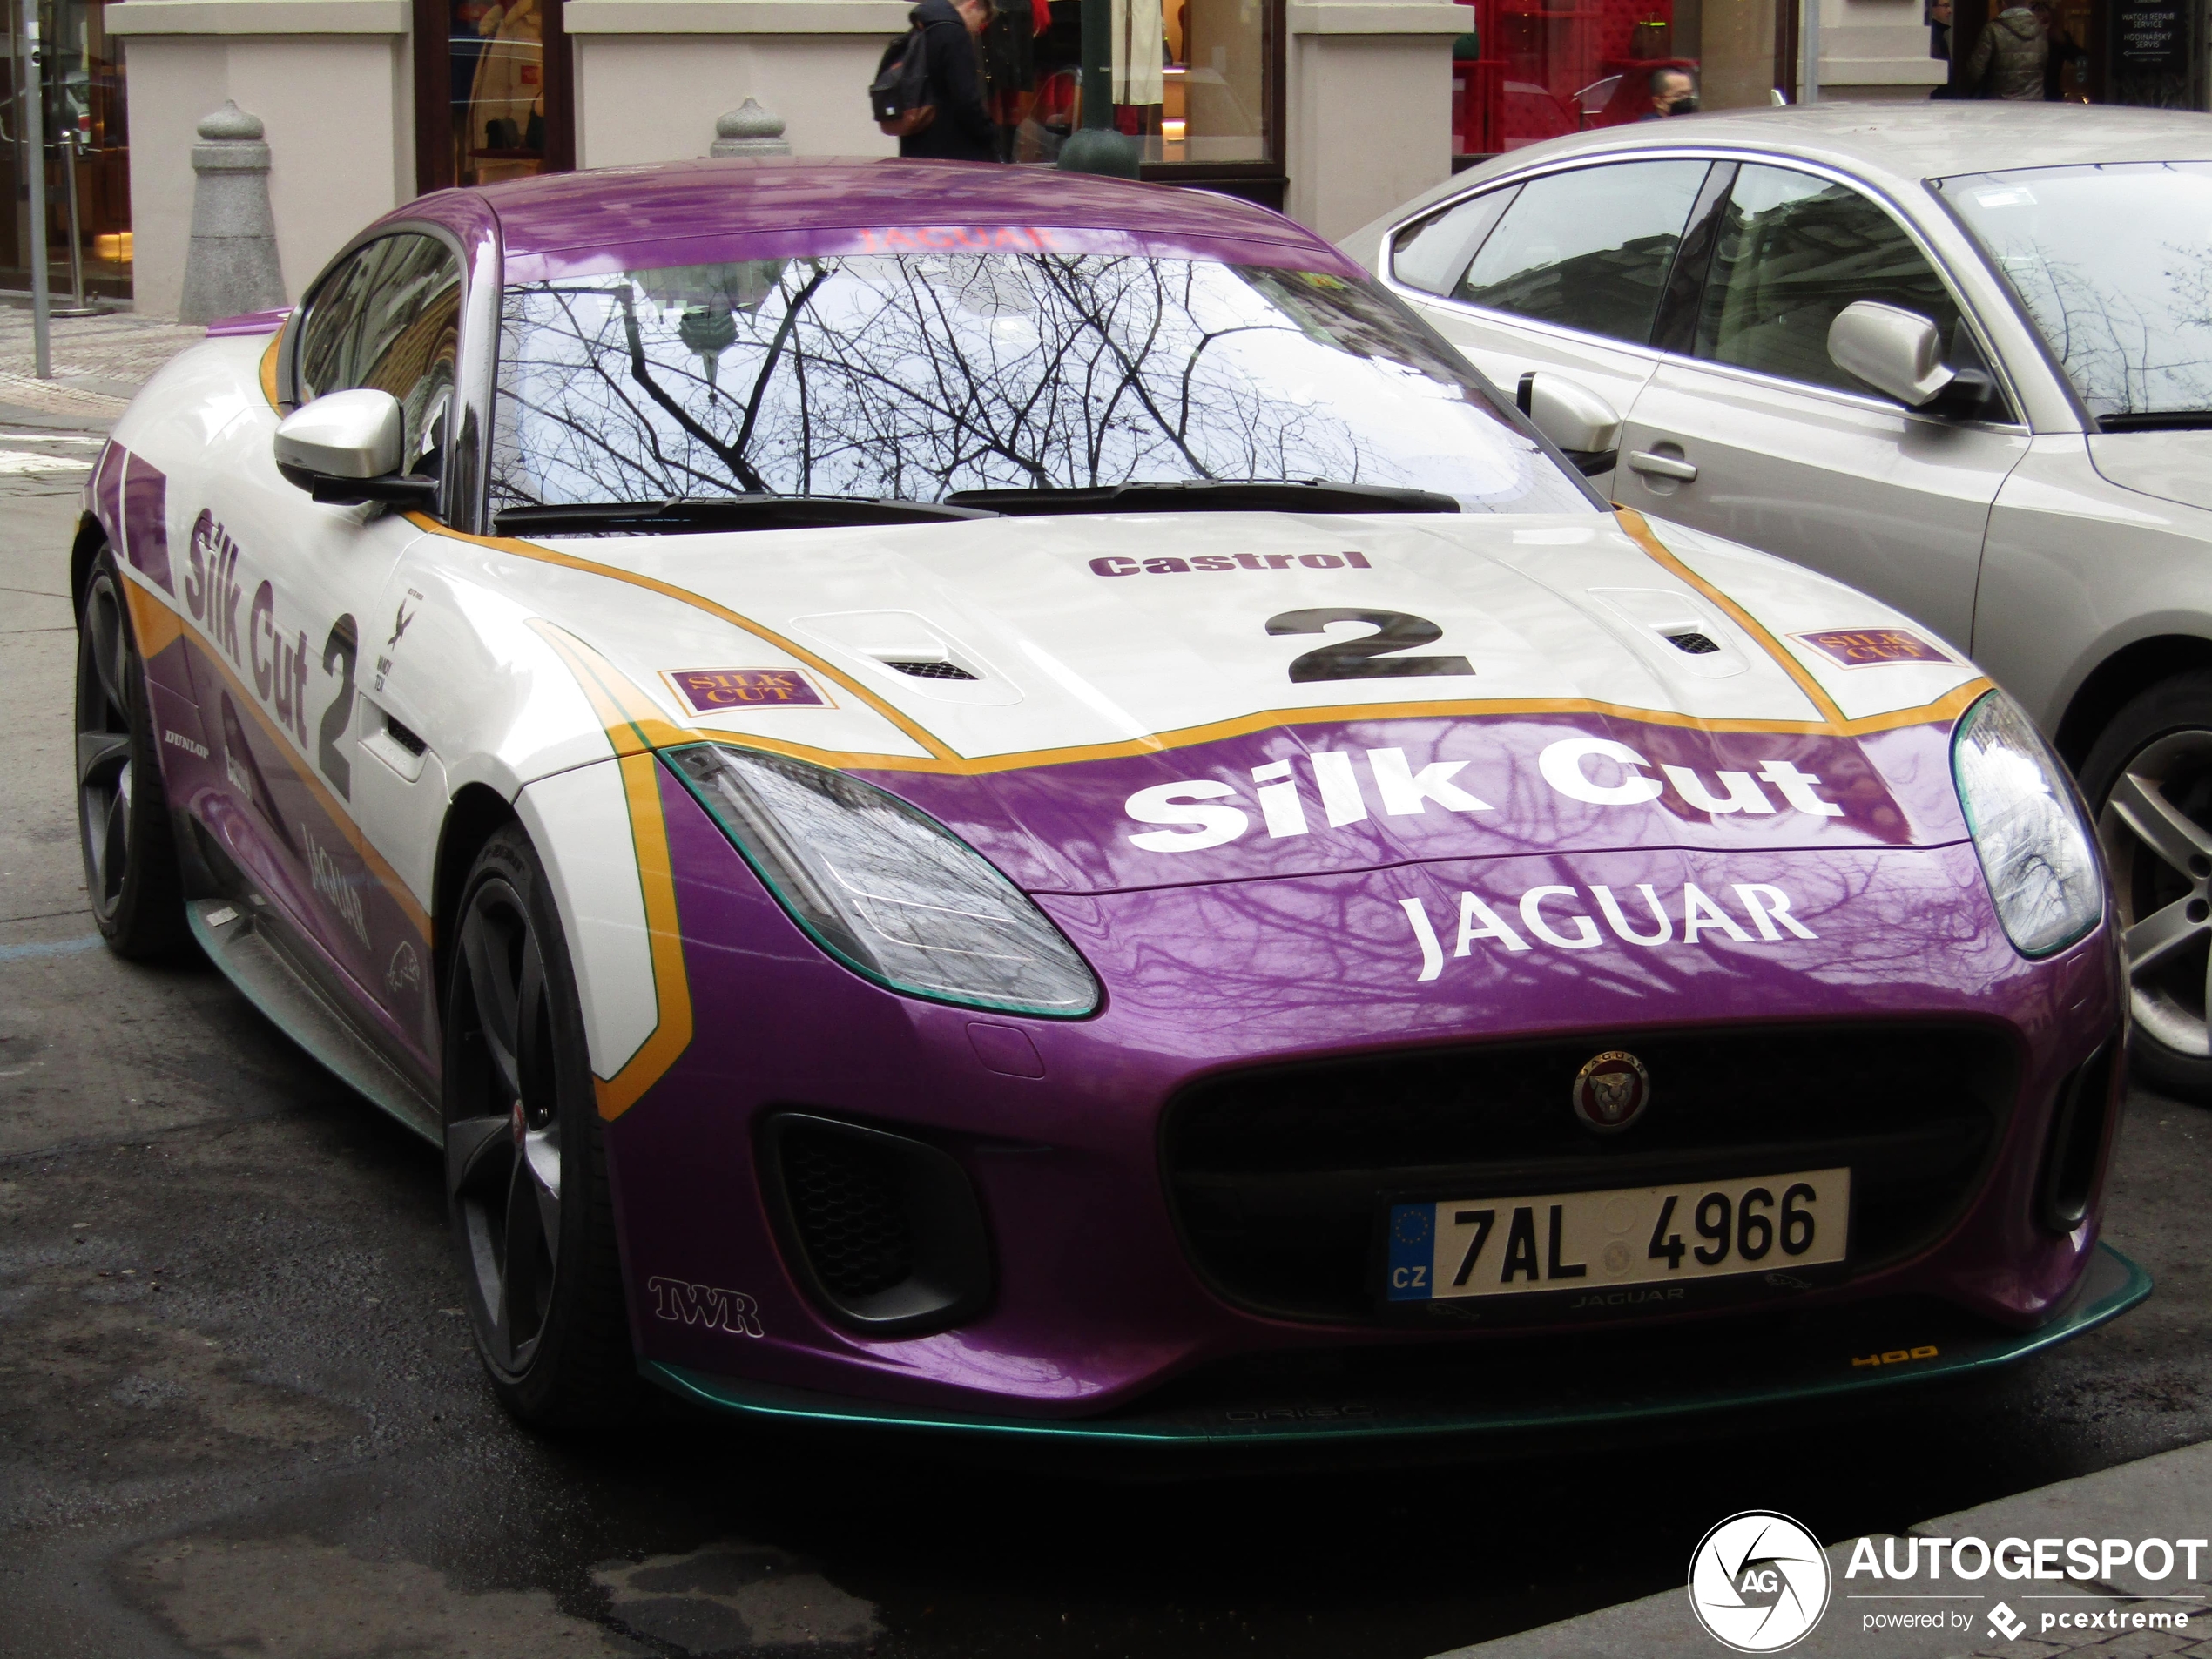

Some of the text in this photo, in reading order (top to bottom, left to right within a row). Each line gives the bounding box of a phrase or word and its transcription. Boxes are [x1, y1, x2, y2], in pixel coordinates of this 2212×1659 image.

[860, 227, 1062, 253] JAGUAR
[1088, 550, 1372, 577] Castrol
[185, 508, 308, 751] Silk Cut
[1818, 633, 1916, 648] SILK
[1264, 607, 1476, 683] 2
[1846, 644, 1921, 659] CUT
[688, 674, 798, 691] SILK
[707, 687, 795, 704] CUT
[320, 613, 359, 804] 2
[165, 730, 209, 759] DUNLOP
[1124, 738, 1846, 853] Silk Cut
[1398, 883, 1819, 981] JAGUAR
[1577, 1051, 1645, 1079] JAGUAR
[1453, 1182, 1817, 1285] 7AL 4966
[1393, 1267, 1426, 1289] CZ
[648, 1276, 765, 1338] TWR
[1571, 1287, 1684, 1308] JAGUAR
[1851, 1345, 1939, 1366] 400
